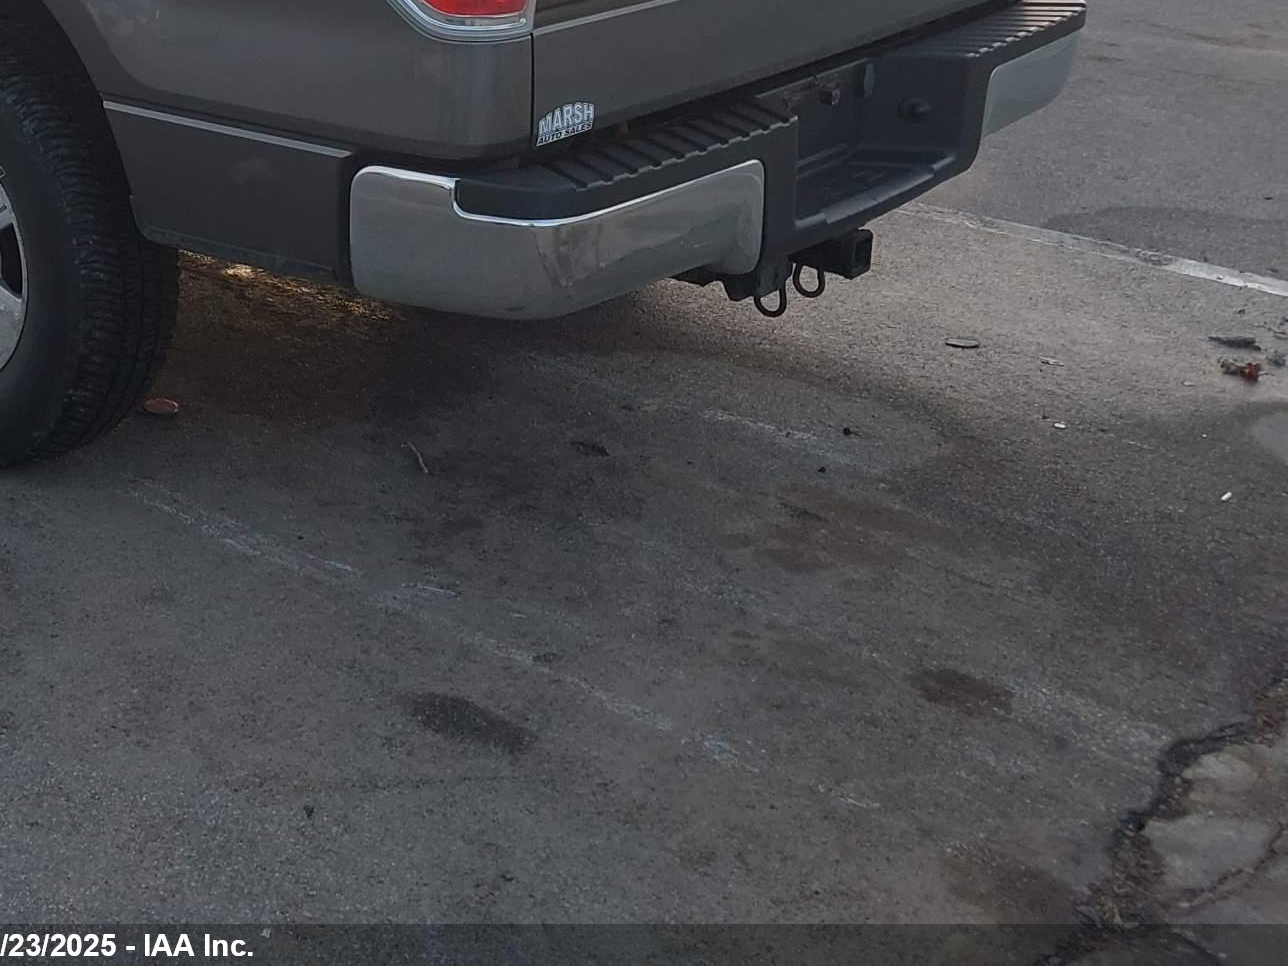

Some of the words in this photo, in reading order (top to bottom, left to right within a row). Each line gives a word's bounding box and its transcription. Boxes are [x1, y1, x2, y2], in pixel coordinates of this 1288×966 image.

[537, 102, 594, 137] MARSH
[537, 130, 562, 146] AUTO
[564, 122, 592, 137] SALES
